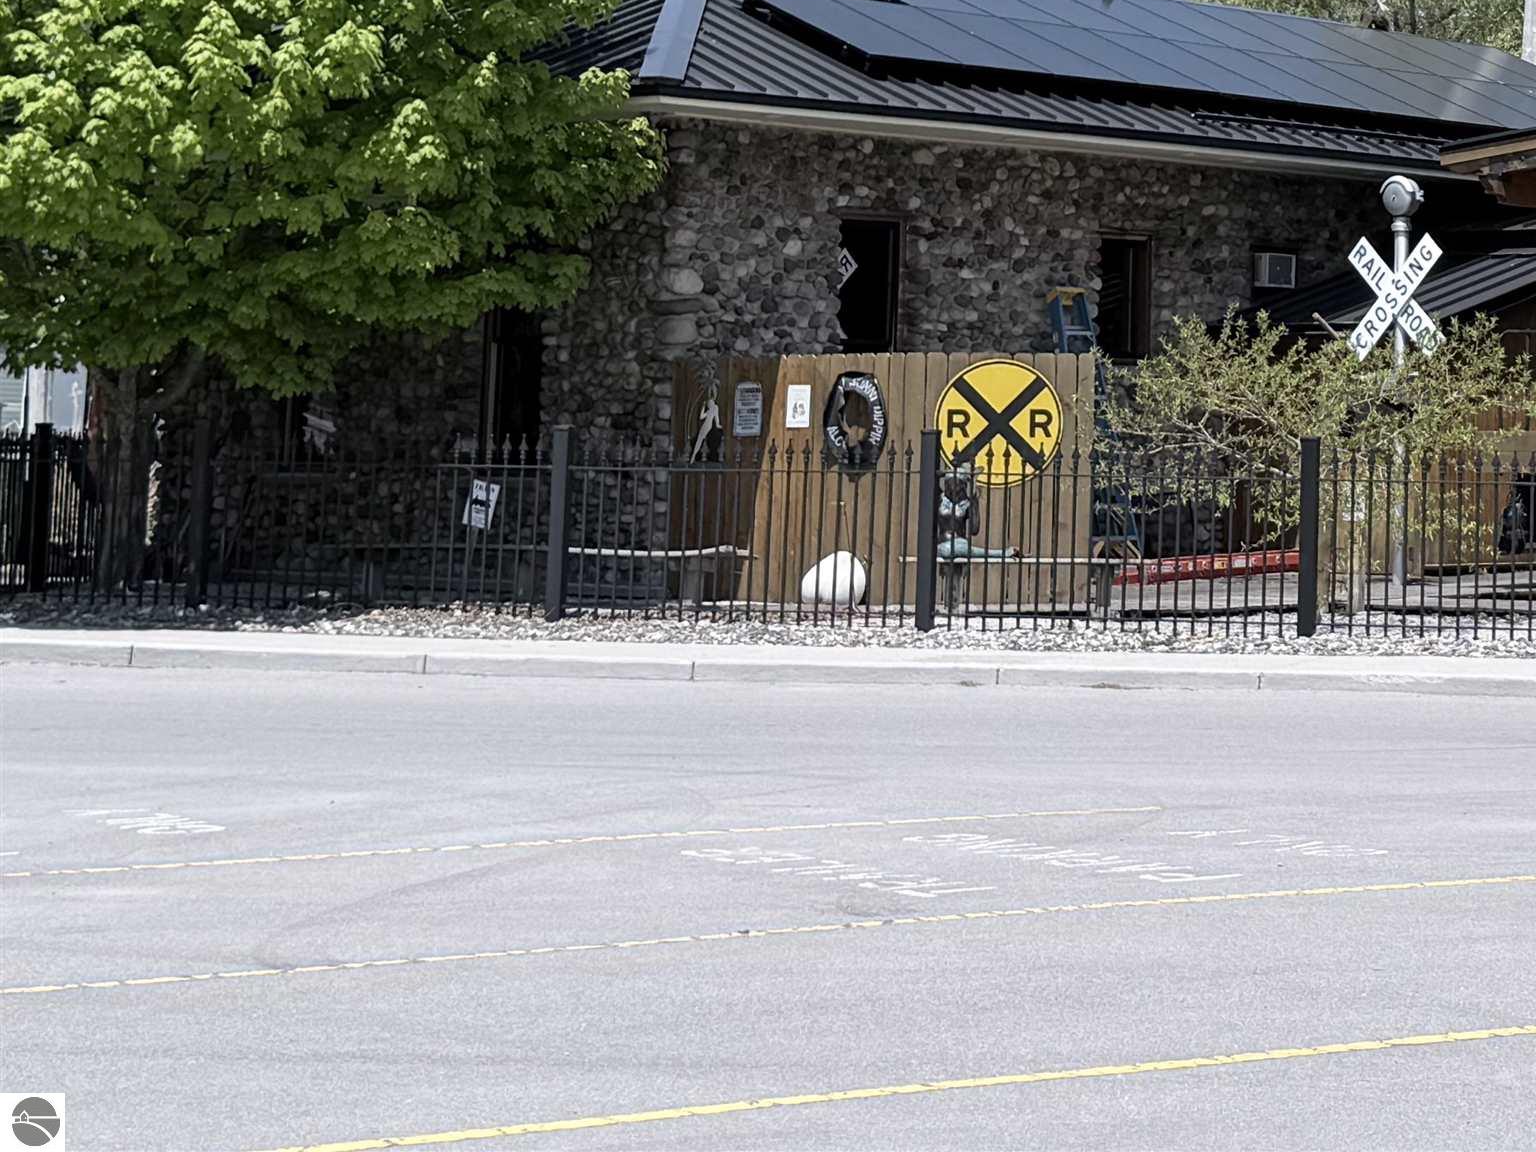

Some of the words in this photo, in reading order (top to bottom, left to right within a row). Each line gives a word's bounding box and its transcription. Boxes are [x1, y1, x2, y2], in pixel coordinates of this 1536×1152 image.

[1354, 245, 1386, 291] RAIL
[1401, 304, 1438, 351] ROAD
[1355, 245, 1433, 349] CROSSING
